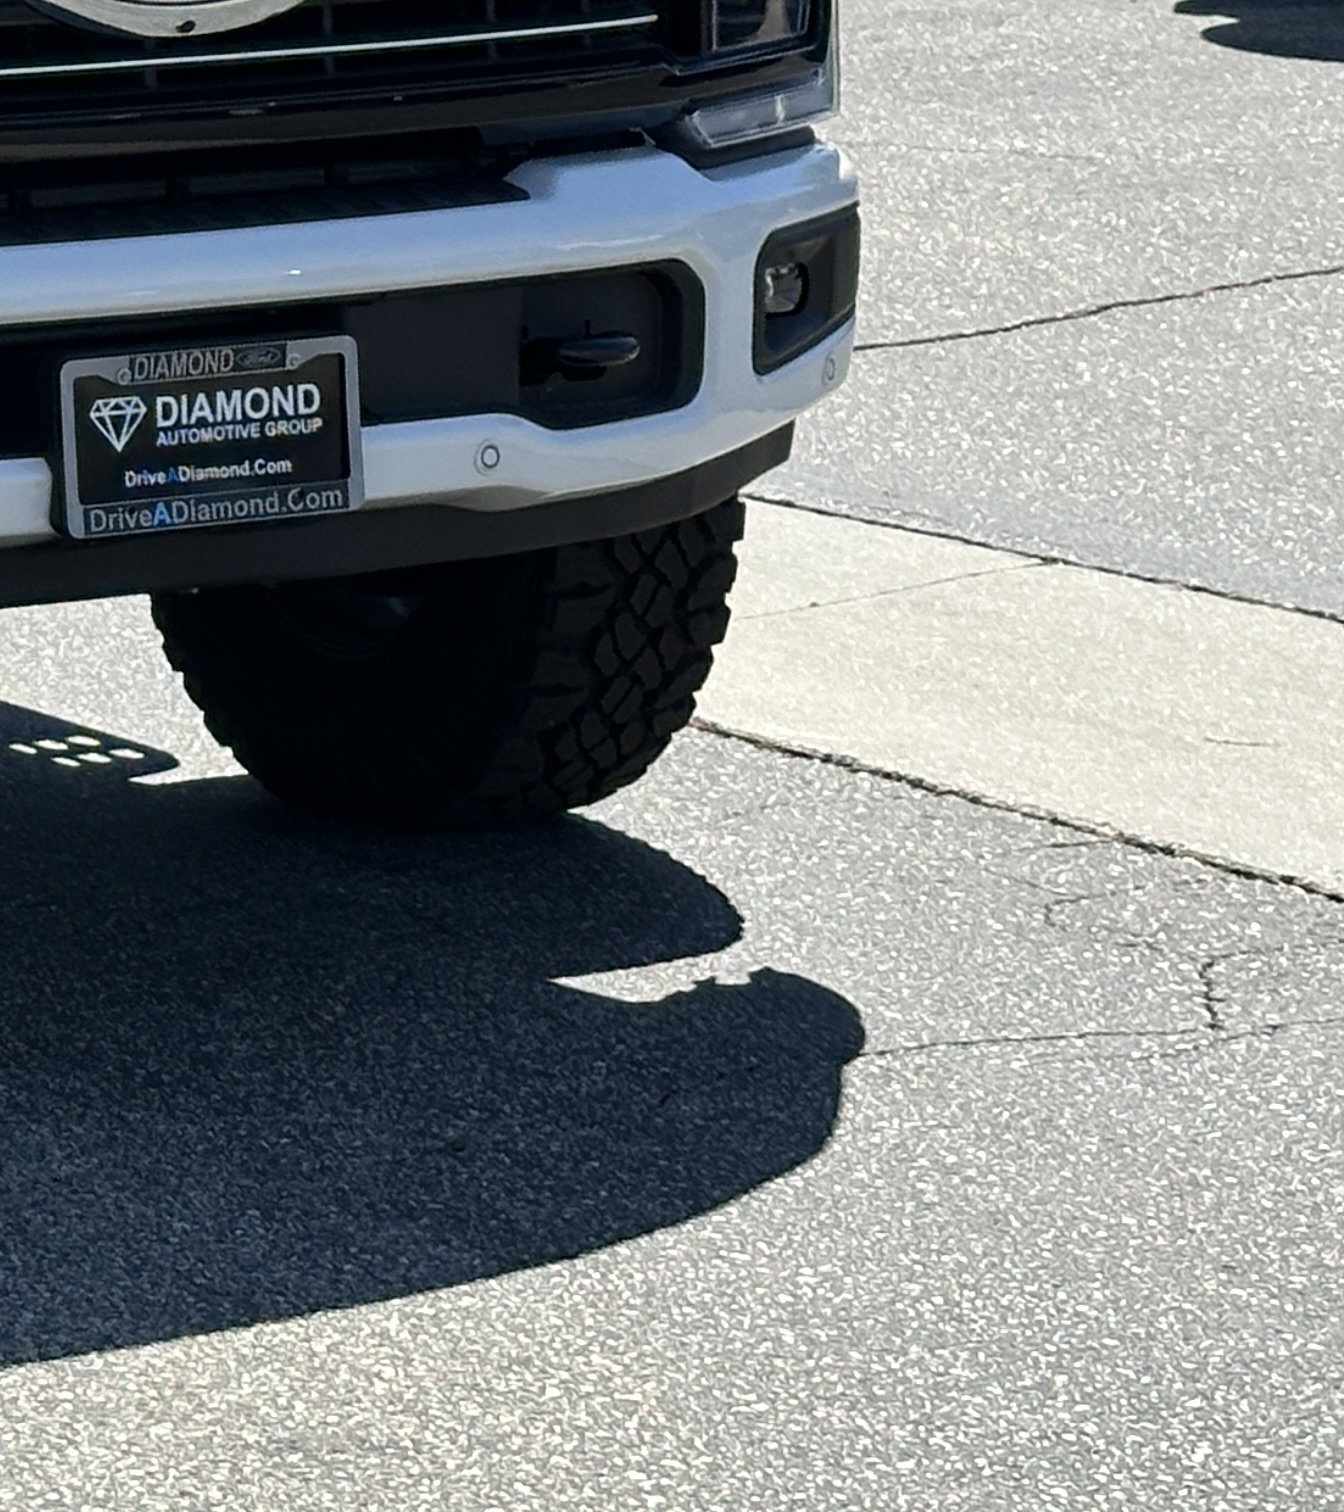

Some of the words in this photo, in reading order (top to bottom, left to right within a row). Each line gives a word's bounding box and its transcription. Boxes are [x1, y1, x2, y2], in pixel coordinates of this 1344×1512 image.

[134, 348, 235, 381] DIAMOND
[155, 383, 322, 428] DIAMOND
[156, 421, 262, 447] AUTOMOTIVE
[264, 417, 323, 438] GROUP
[124, 459, 293, 488] DriveADiamond.Com
[89, 487, 343, 533] DriveADiamond.Com
